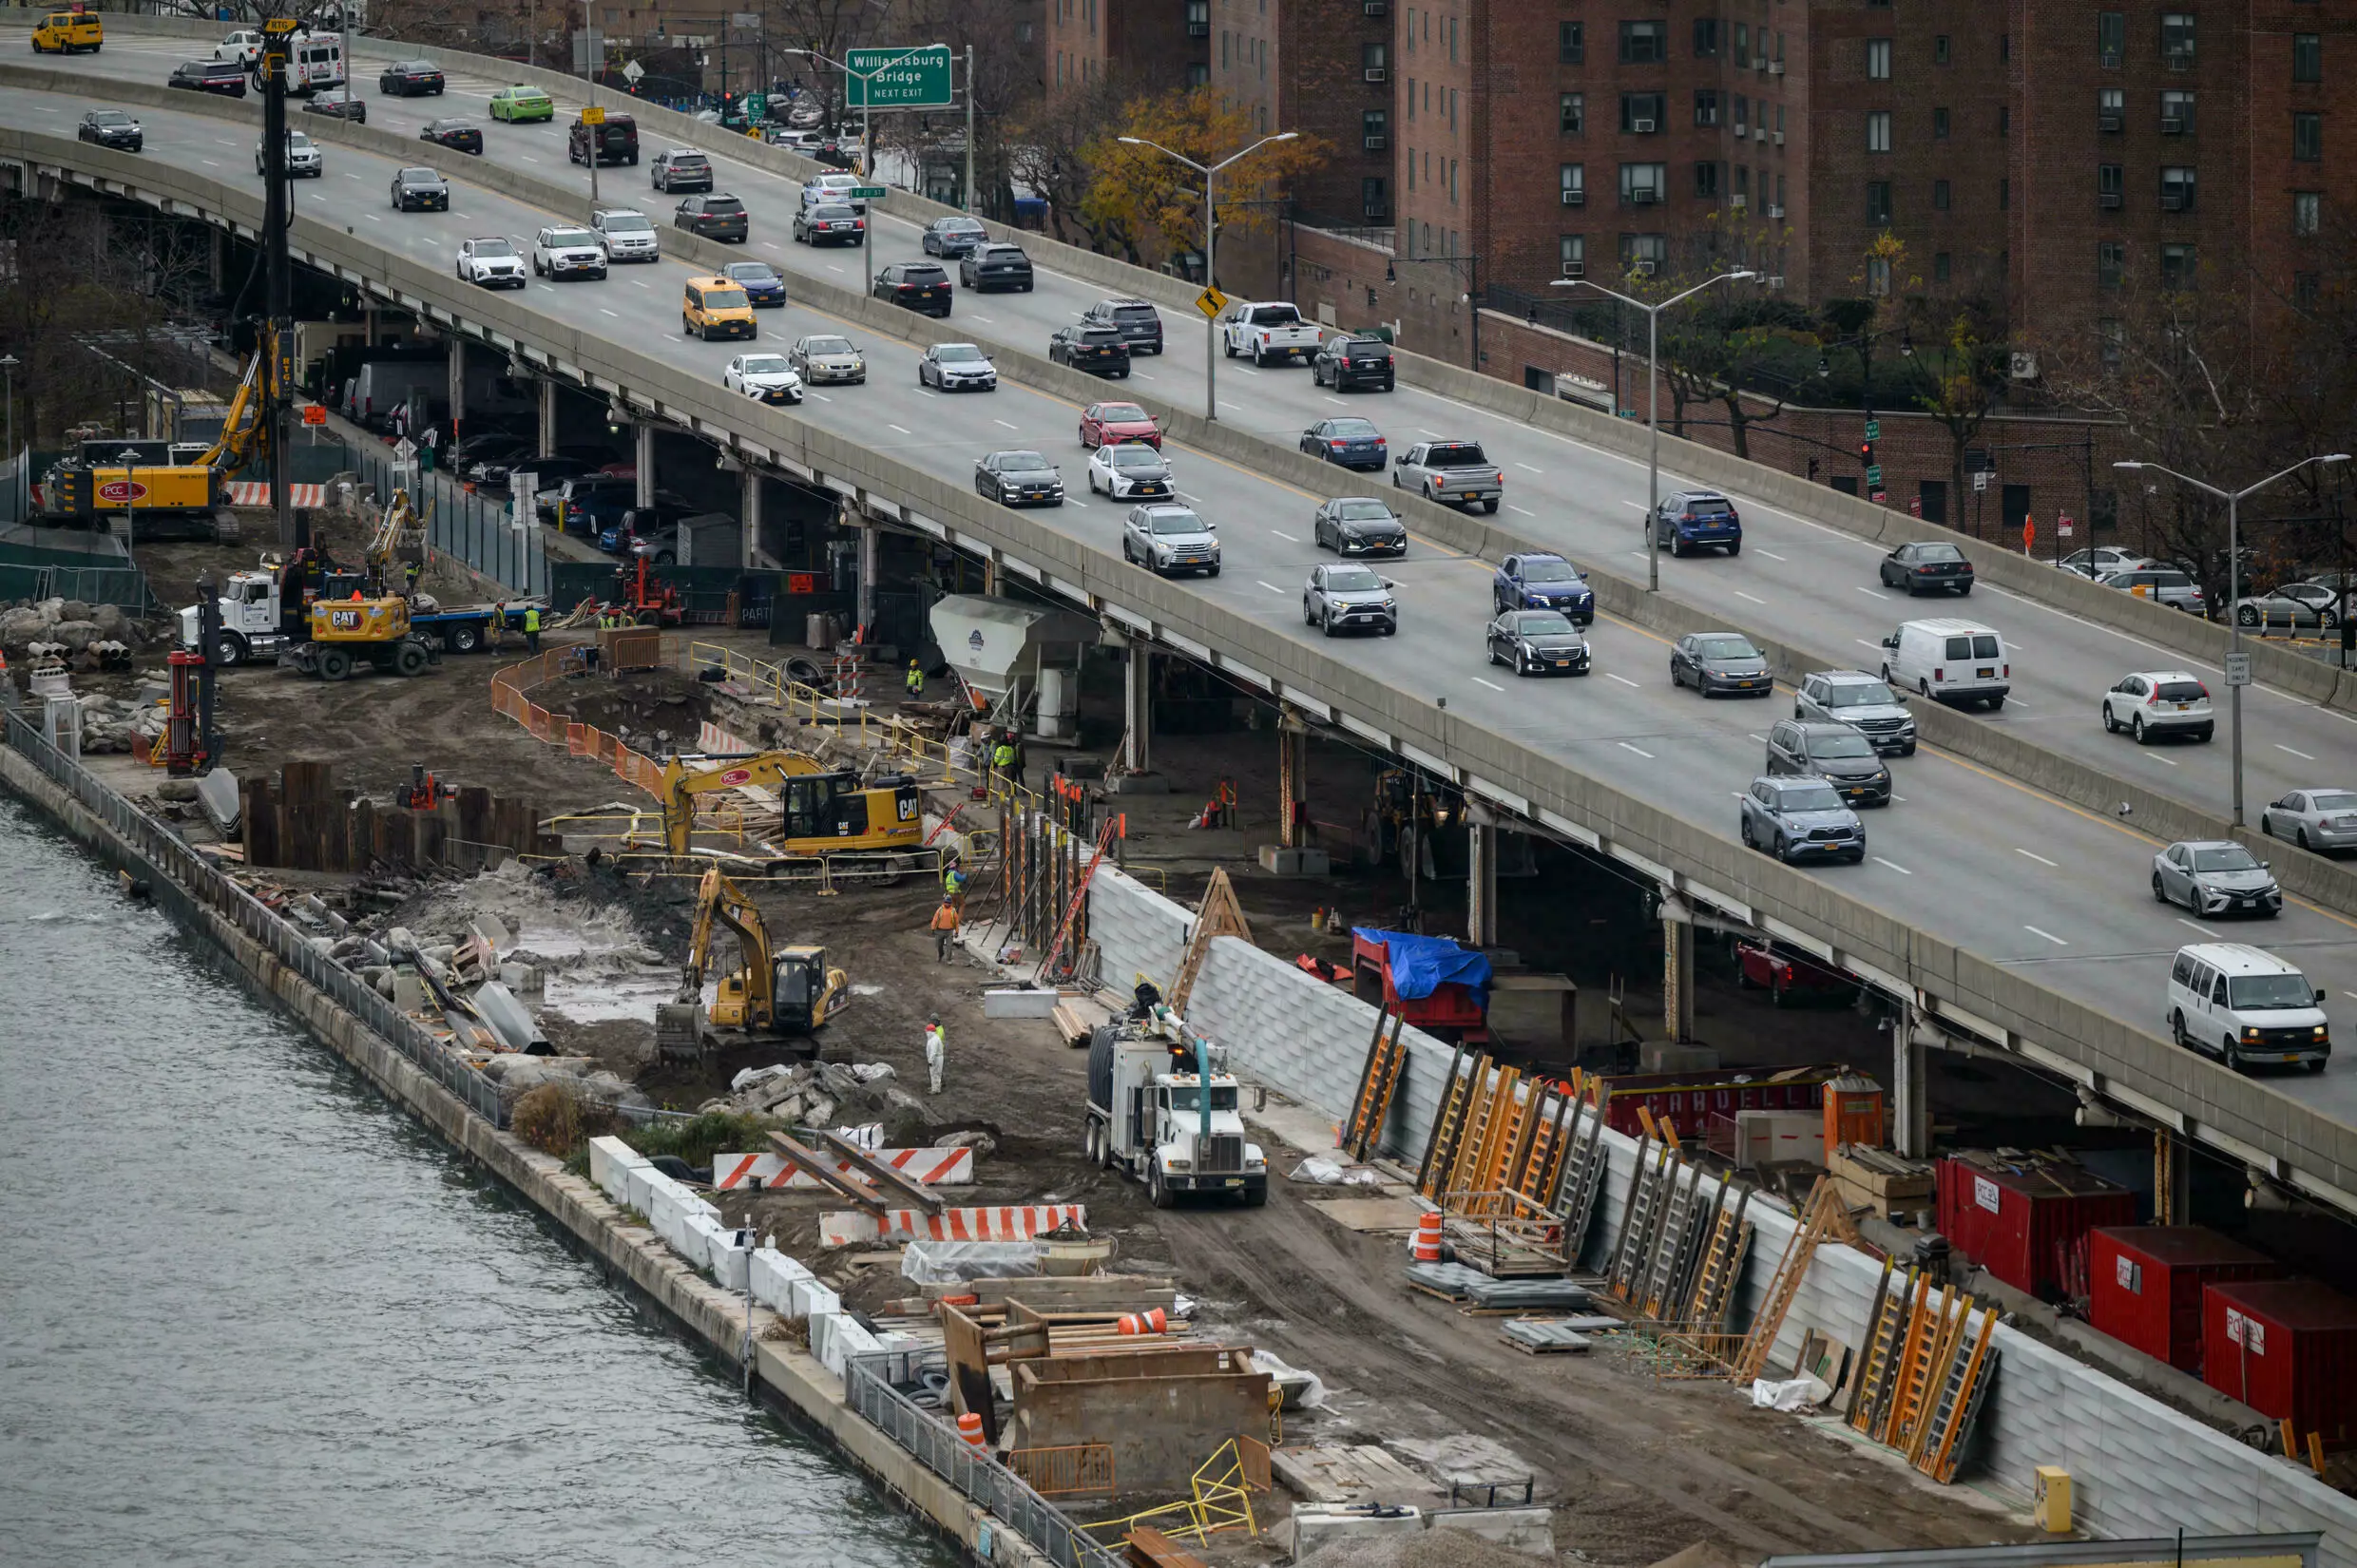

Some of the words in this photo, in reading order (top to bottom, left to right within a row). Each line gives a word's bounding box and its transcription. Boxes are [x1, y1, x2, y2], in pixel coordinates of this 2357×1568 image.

[271, 21, 288, 29] RTG
[853, 55, 944, 68] Williamsburg
[876, 71, 922, 85] Bridge
[874, 89, 899, 98] NEXT
[902, 88, 923, 97] EXIT
[105, 486, 124, 495] PCC
[332, 611, 356, 627] CAT
[899, 798, 917, 820] CAT
